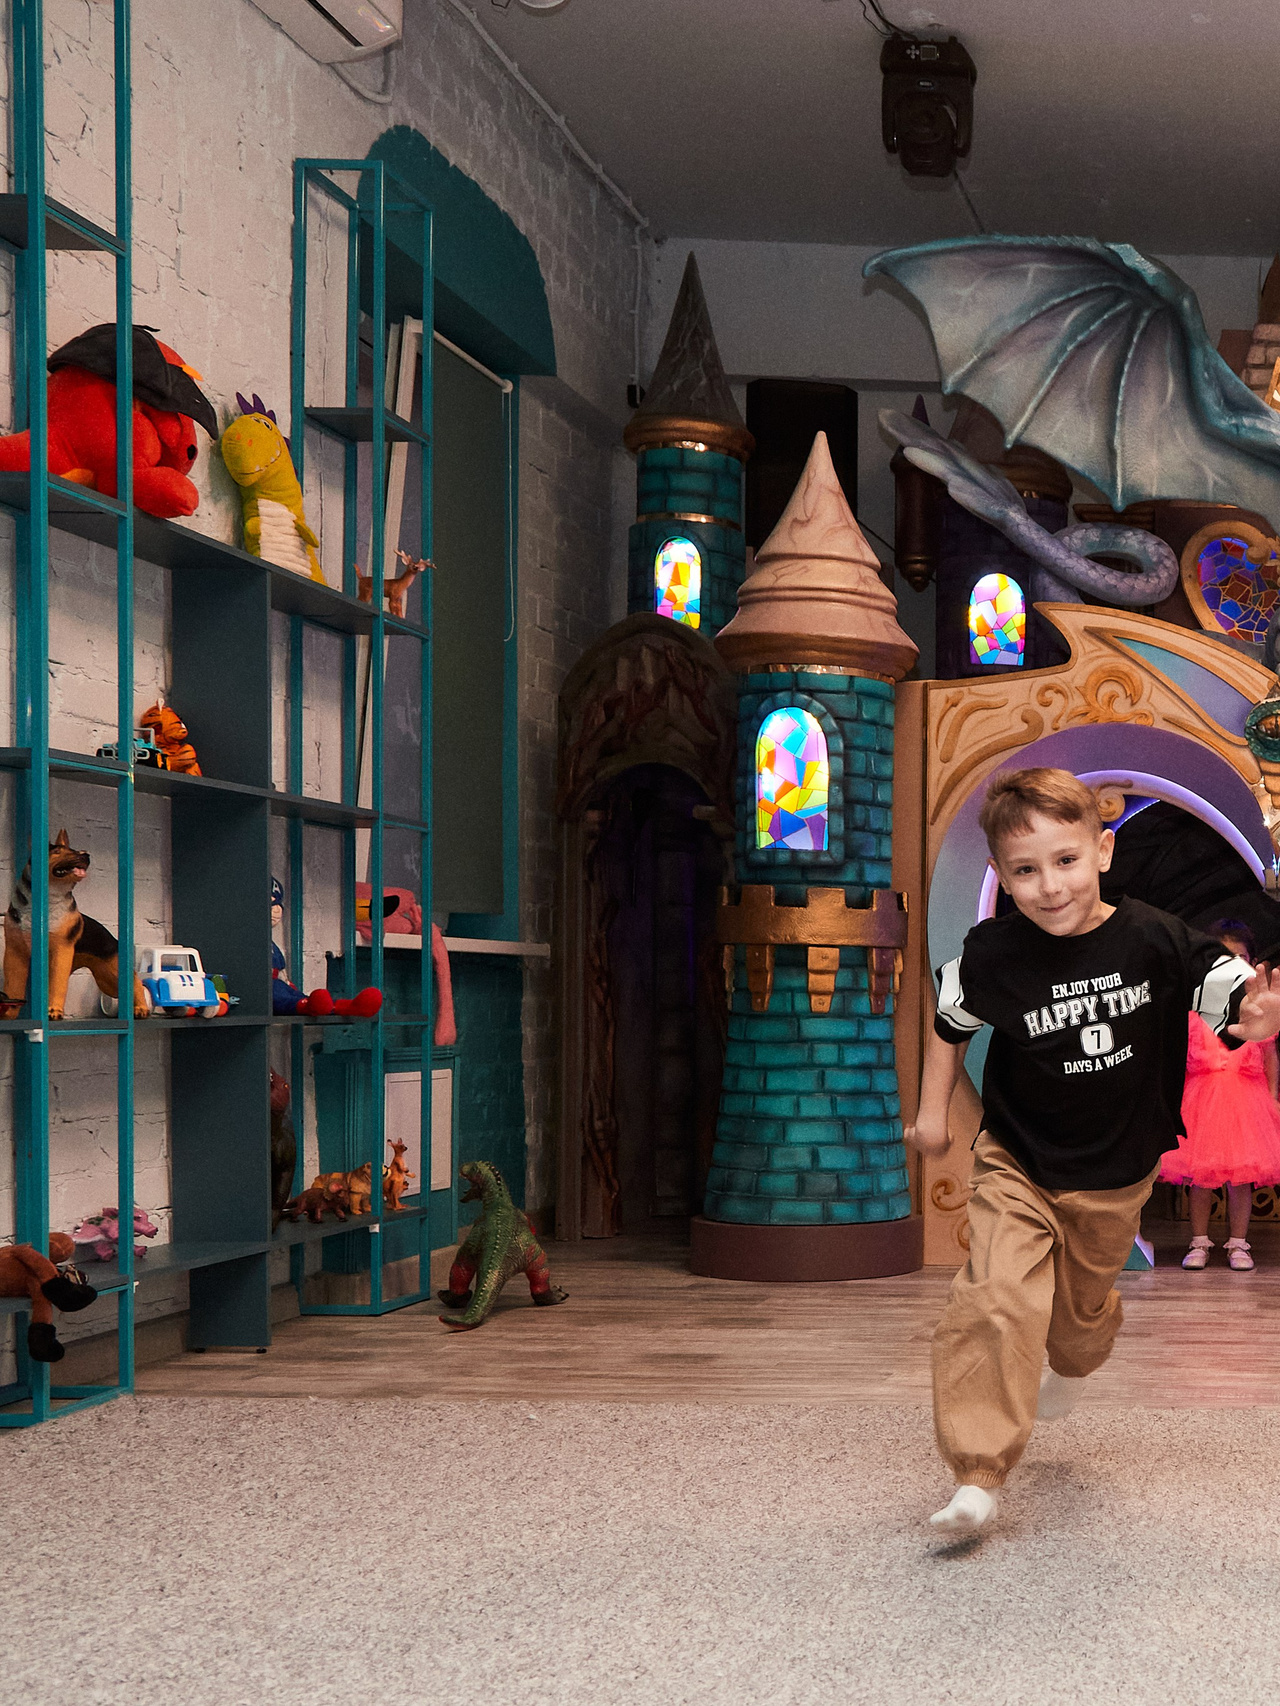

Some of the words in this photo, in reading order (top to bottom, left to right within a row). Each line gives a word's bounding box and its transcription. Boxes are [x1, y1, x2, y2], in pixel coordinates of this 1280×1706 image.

[1051, 980, 1090, 999] ENJOY
[1091, 972, 1123, 992] YOUR
[1023, 995, 1099, 1038] HAPPY
[1101, 980, 1152, 1018] TIME
[1090, 1029, 1101, 1050] 7
[1063, 1059, 1093, 1075] DAYS
[1094, 1058, 1103, 1071] A
[1103, 1044, 1134, 1069] WEEK
